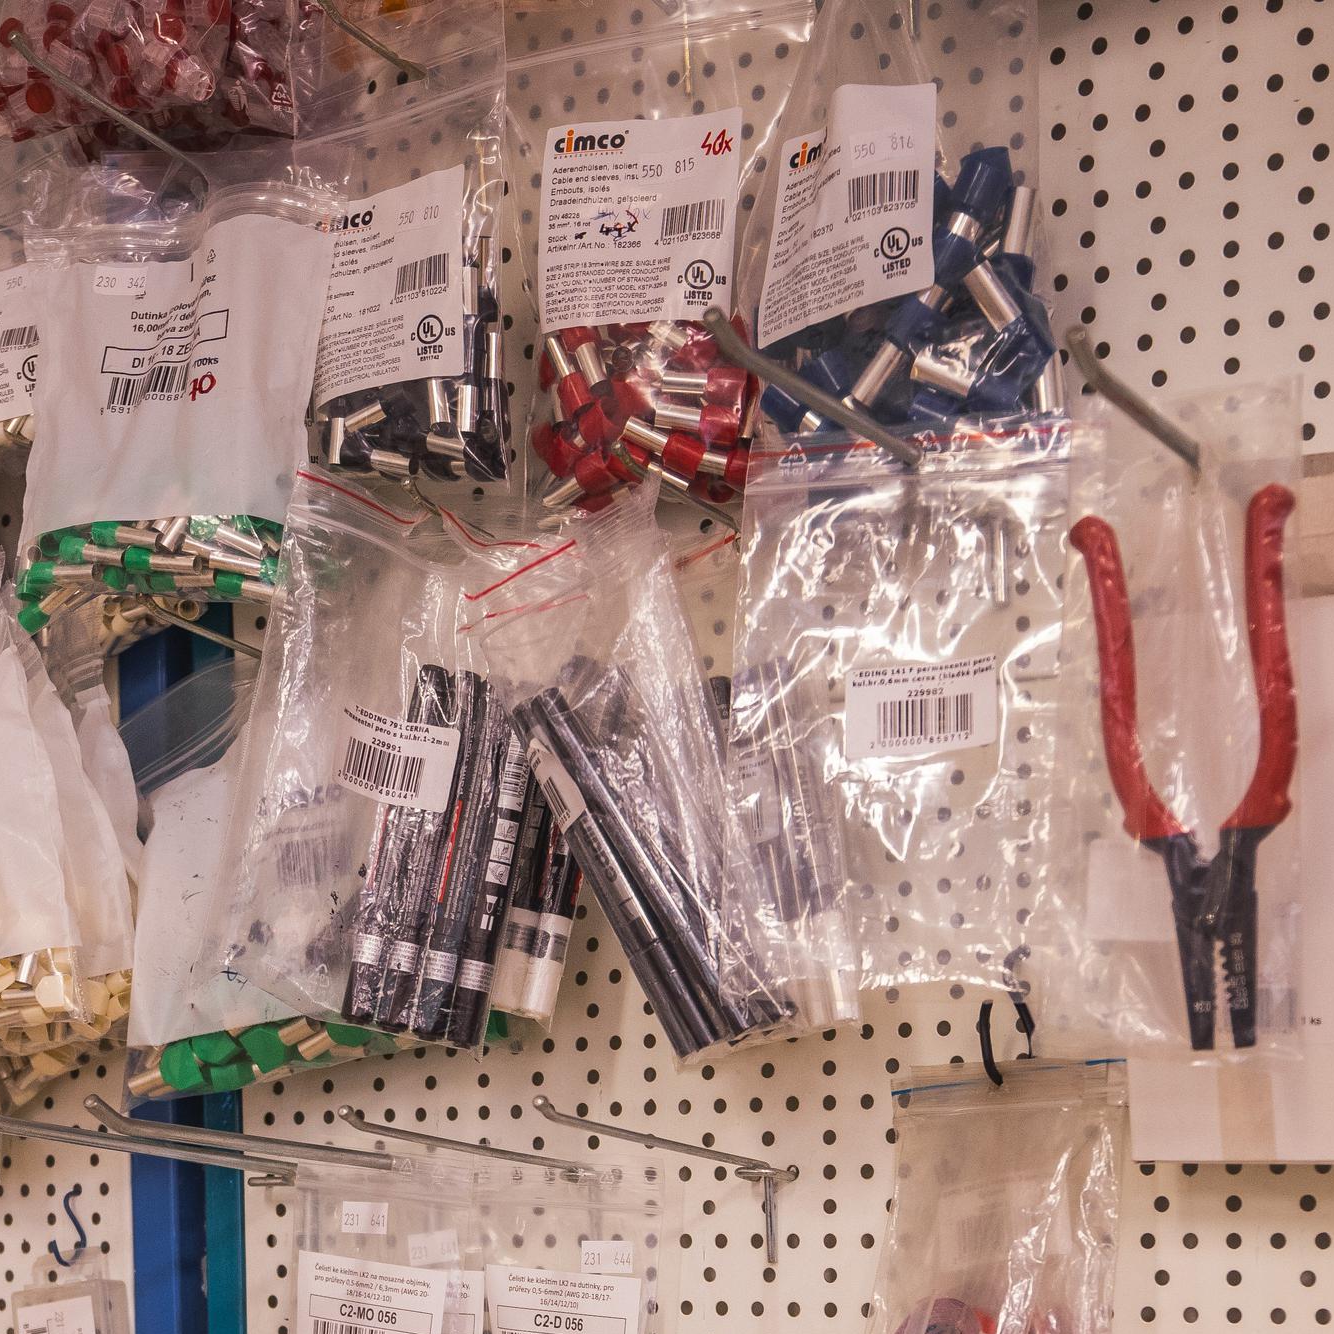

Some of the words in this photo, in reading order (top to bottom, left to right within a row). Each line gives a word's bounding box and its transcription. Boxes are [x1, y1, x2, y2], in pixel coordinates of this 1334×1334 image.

[554, 130, 625, 153] cimco
[854, 144, 876, 159] 550
[642, 164, 662, 177] 550
[675, 158, 695, 173] 815
[552, 177, 573, 185] Cable
[551, 186, 585, 196] Embouts,
[588, 185, 609, 193] isolés
[398, 209, 415, 226] 550
[613, 240, 641, 249] 182366
[882, 258, 911, 273] LISTED
[96, 276, 116, 288] 230
[127, 277, 146, 288] 342
[684, 290, 712, 300] LISTED
[417, 345, 443, 355] LISTED
[355, 705, 387, 724] T-EDDING
[372, 737, 402, 753] 229991
[344, 1213, 359, 1226] 231
[370, 1213, 385, 1227] 641
[584, 1252, 601, 1265] 231
[613, 1253, 631, 1265] 644
[339, 1303, 375, 1321] C2-MO
[378, 1311, 397, 1325] 056
[534, 1314, 562, 1329] C2-D
[565, 1317, 584, 1331] 056
